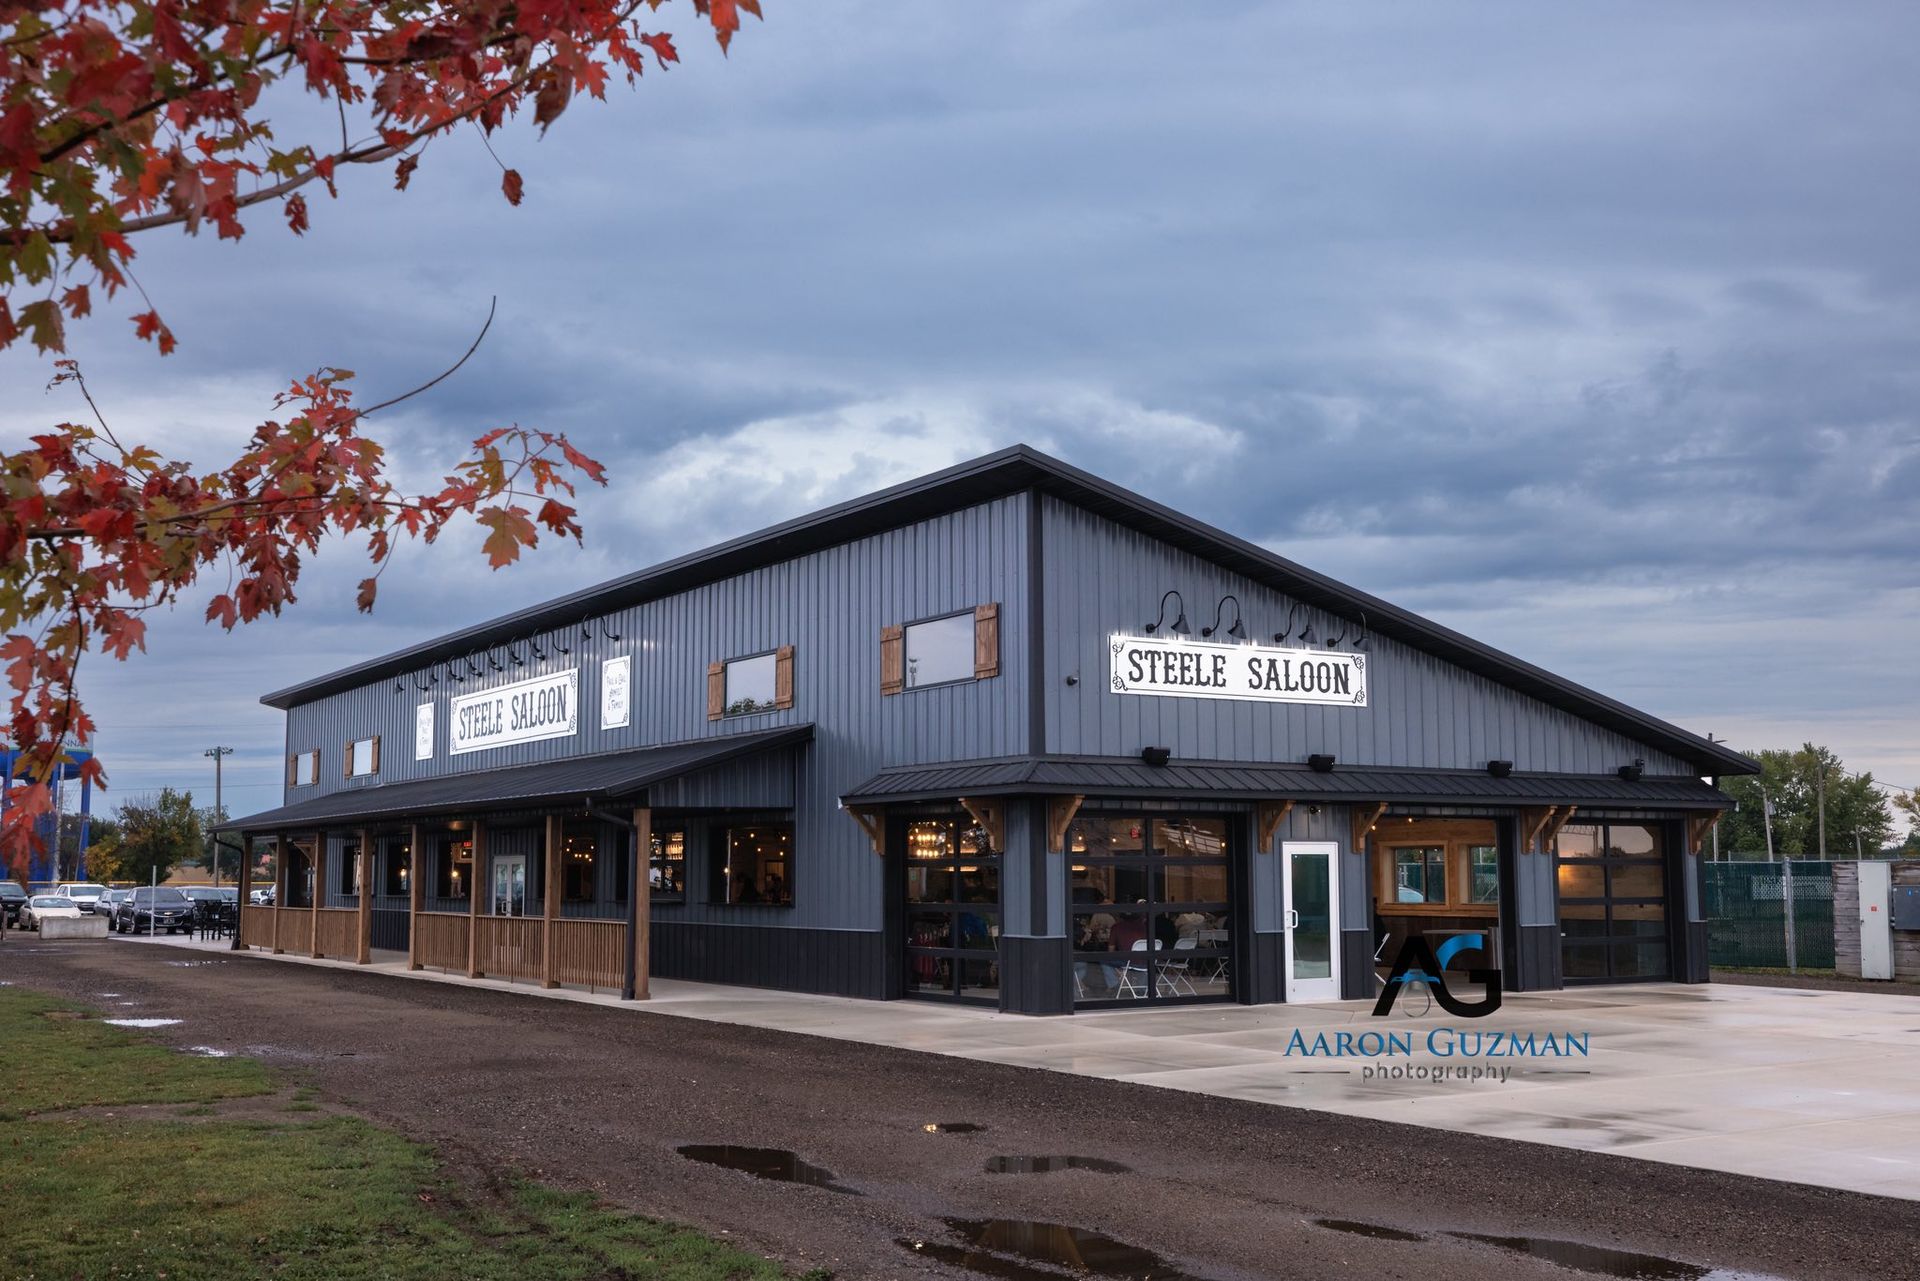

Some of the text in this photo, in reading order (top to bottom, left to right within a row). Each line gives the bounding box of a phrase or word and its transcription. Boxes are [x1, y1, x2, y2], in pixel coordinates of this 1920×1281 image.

[1128, 649, 1351, 695] STEELE SALOON
[459, 699, 504, 741] STEELE
[511, 684, 568, 731] SALOON
